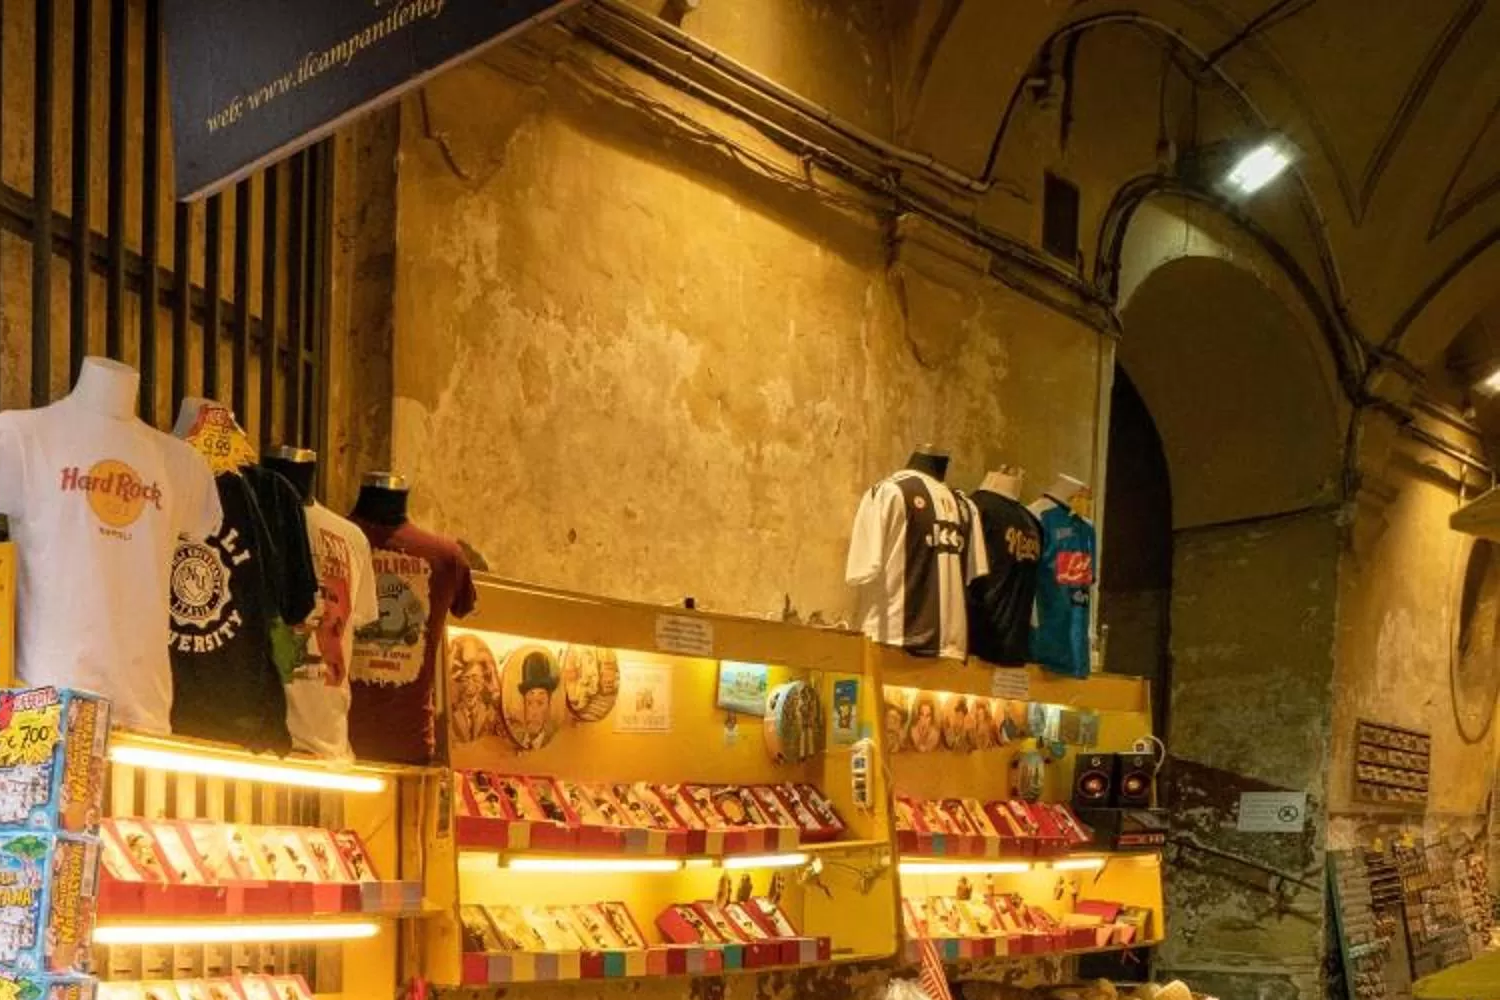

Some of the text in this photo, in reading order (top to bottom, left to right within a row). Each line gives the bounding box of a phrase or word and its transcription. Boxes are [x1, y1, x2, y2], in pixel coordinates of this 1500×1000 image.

[60, 466, 162, 510] Hard Rock
[169, 609, 242, 653] VERSITY
